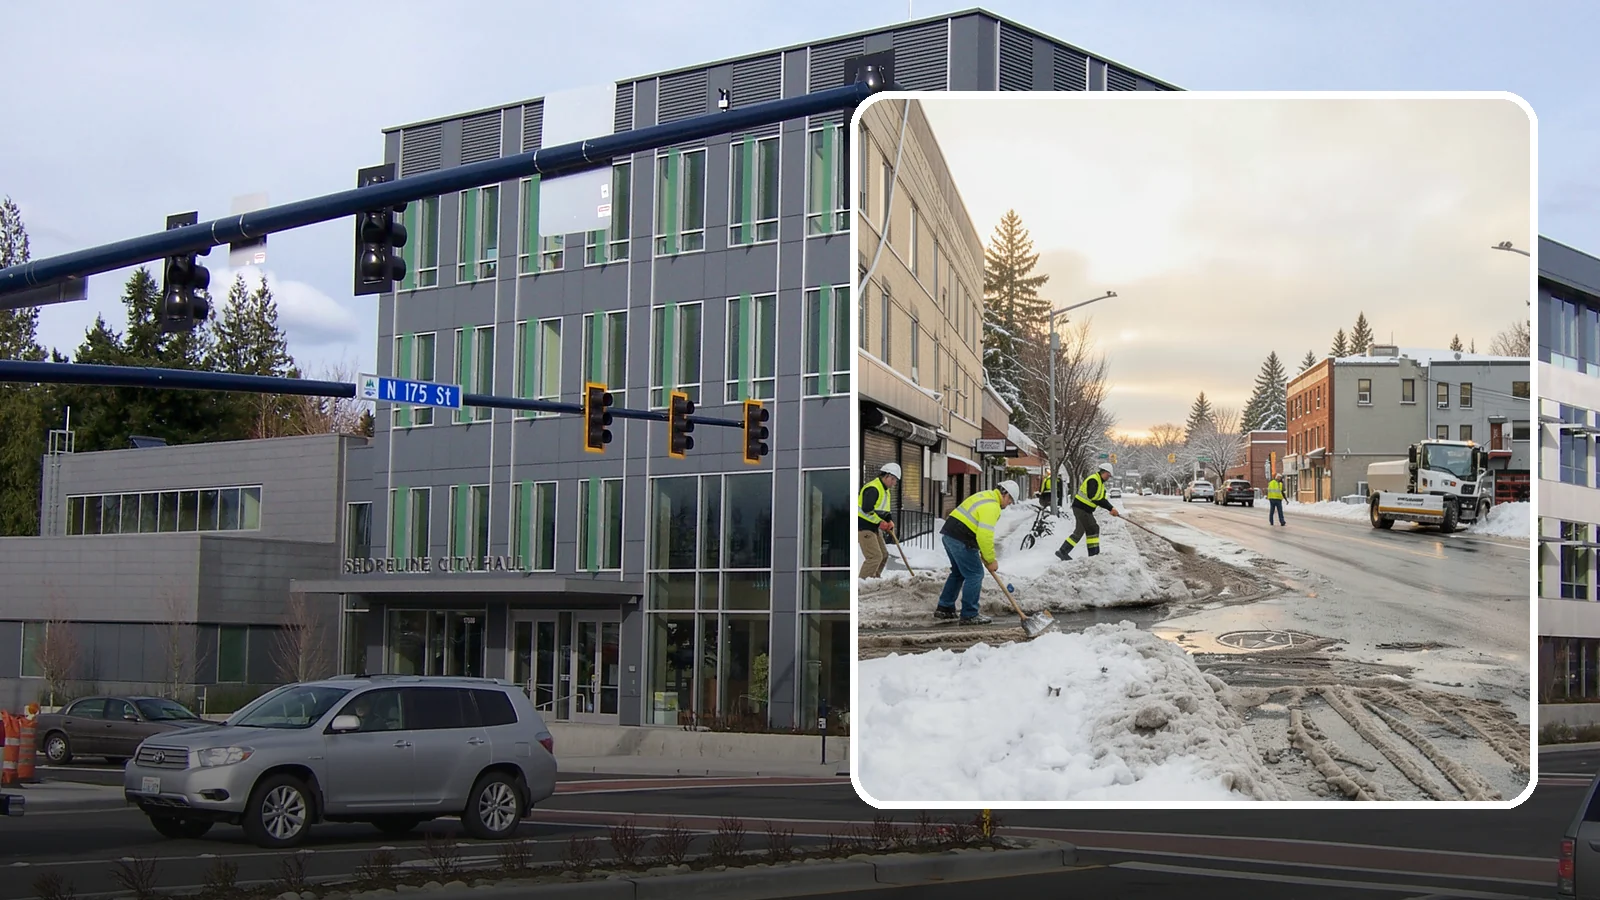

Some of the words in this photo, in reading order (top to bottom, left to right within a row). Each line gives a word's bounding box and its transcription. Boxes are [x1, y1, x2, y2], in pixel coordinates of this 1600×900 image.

[387, 380, 396, 400] N
[405, 382, 427, 403] 175
[436, 386, 451, 406] St
[343, 557, 432, 574] SHORELINE
[438, 556, 476, 572] CITY
[482, 555, 525, 572] HALL
